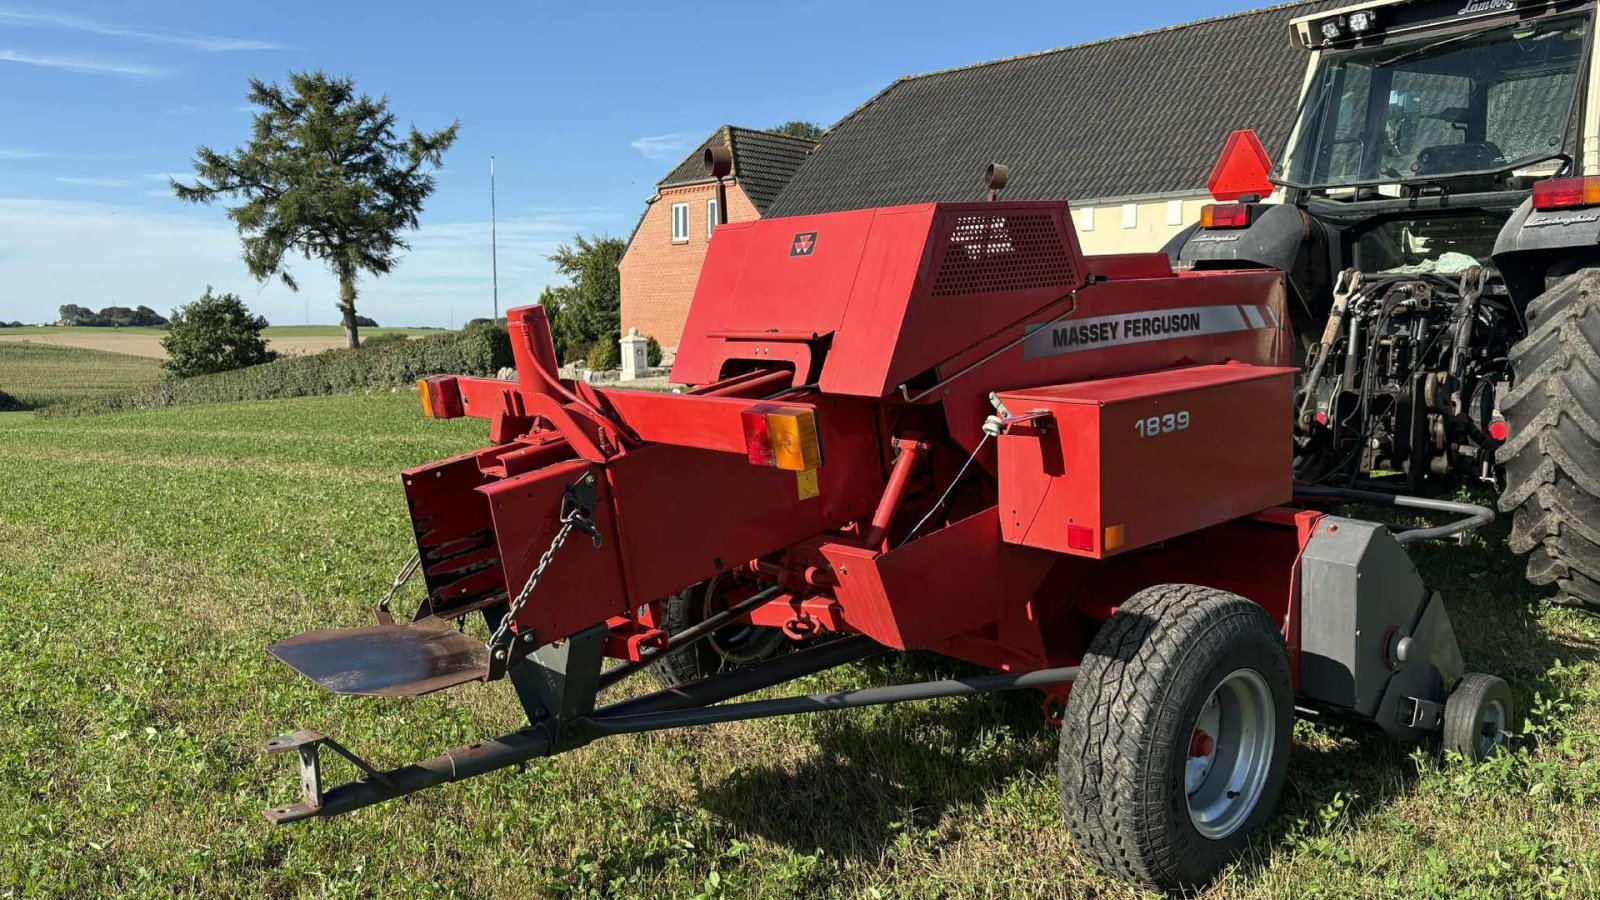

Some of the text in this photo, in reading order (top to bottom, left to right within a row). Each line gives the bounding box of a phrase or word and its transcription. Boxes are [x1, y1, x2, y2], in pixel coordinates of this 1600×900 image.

[1053, 312, 1200, 348] MASSEY FERGUSON
[1135, 411, 1190, 438] 1839
